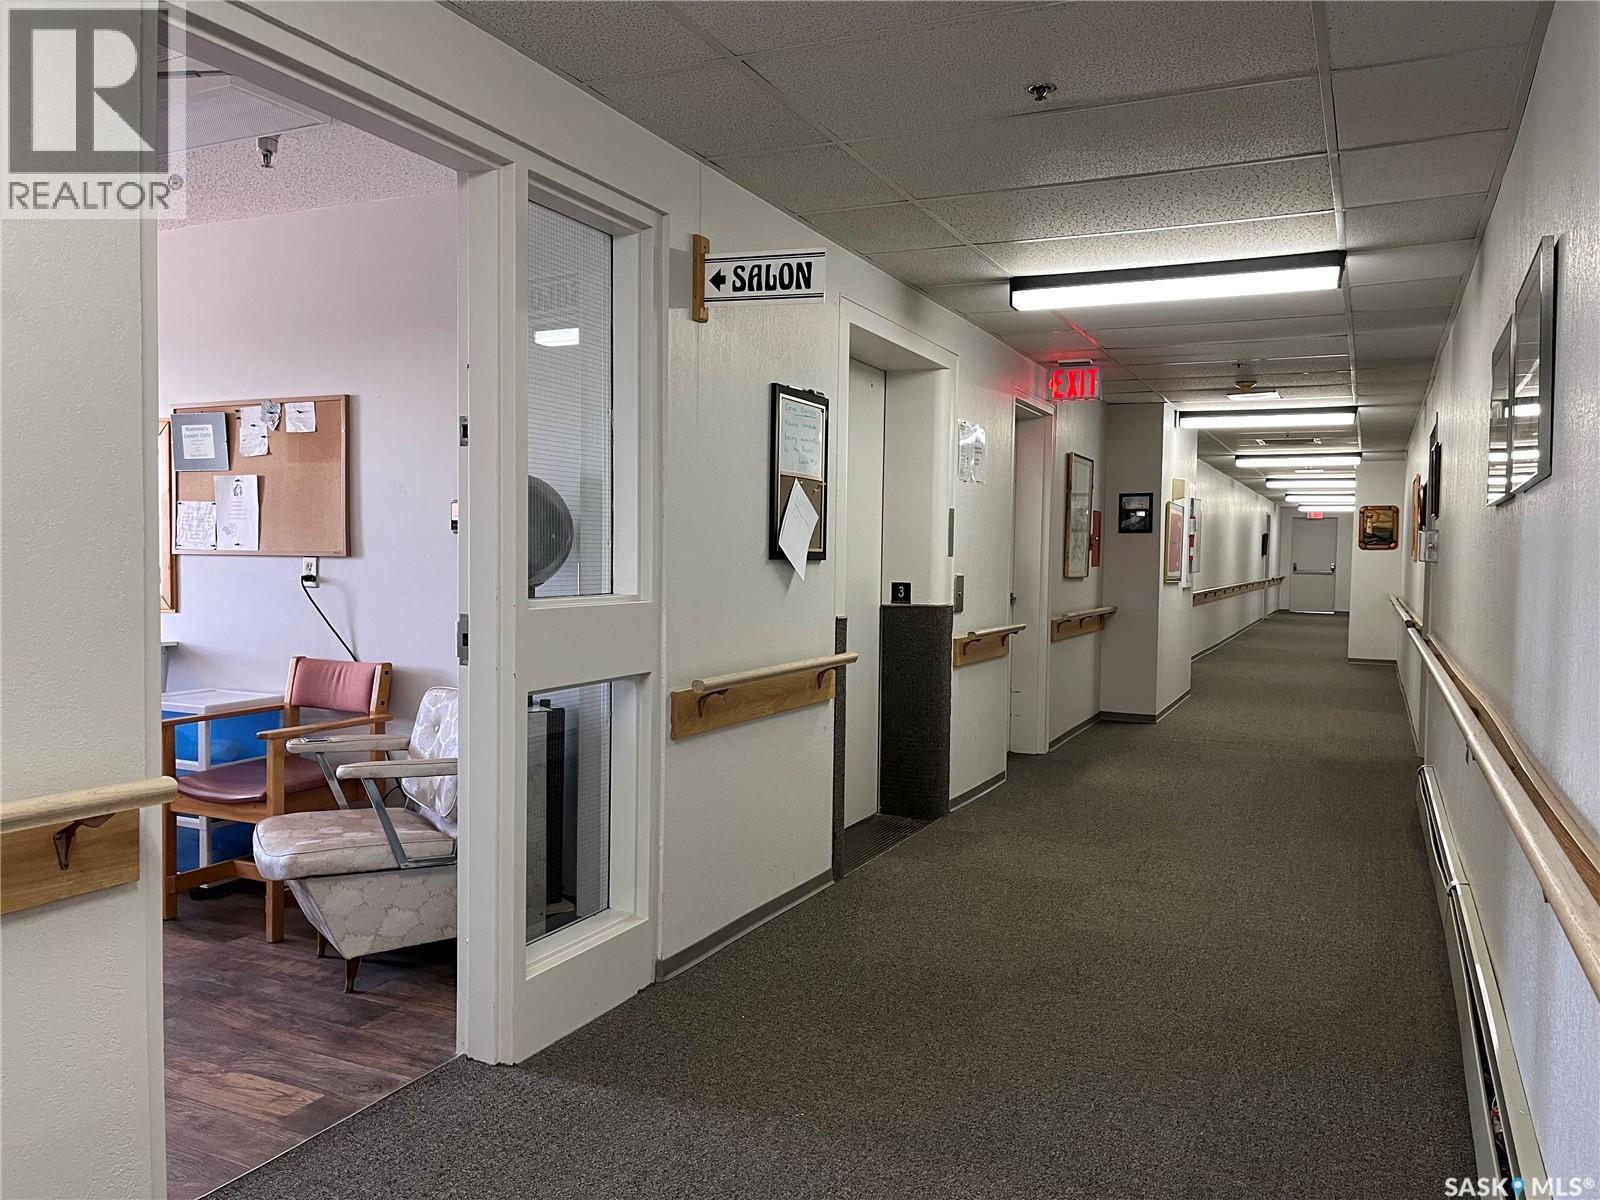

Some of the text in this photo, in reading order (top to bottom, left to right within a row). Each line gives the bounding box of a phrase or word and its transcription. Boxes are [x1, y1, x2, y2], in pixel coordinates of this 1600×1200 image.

[732, 262, 812, 292] SALON
[1053, 368, 1099, 399] EXIT
[898, 586, 905, 598] 3
